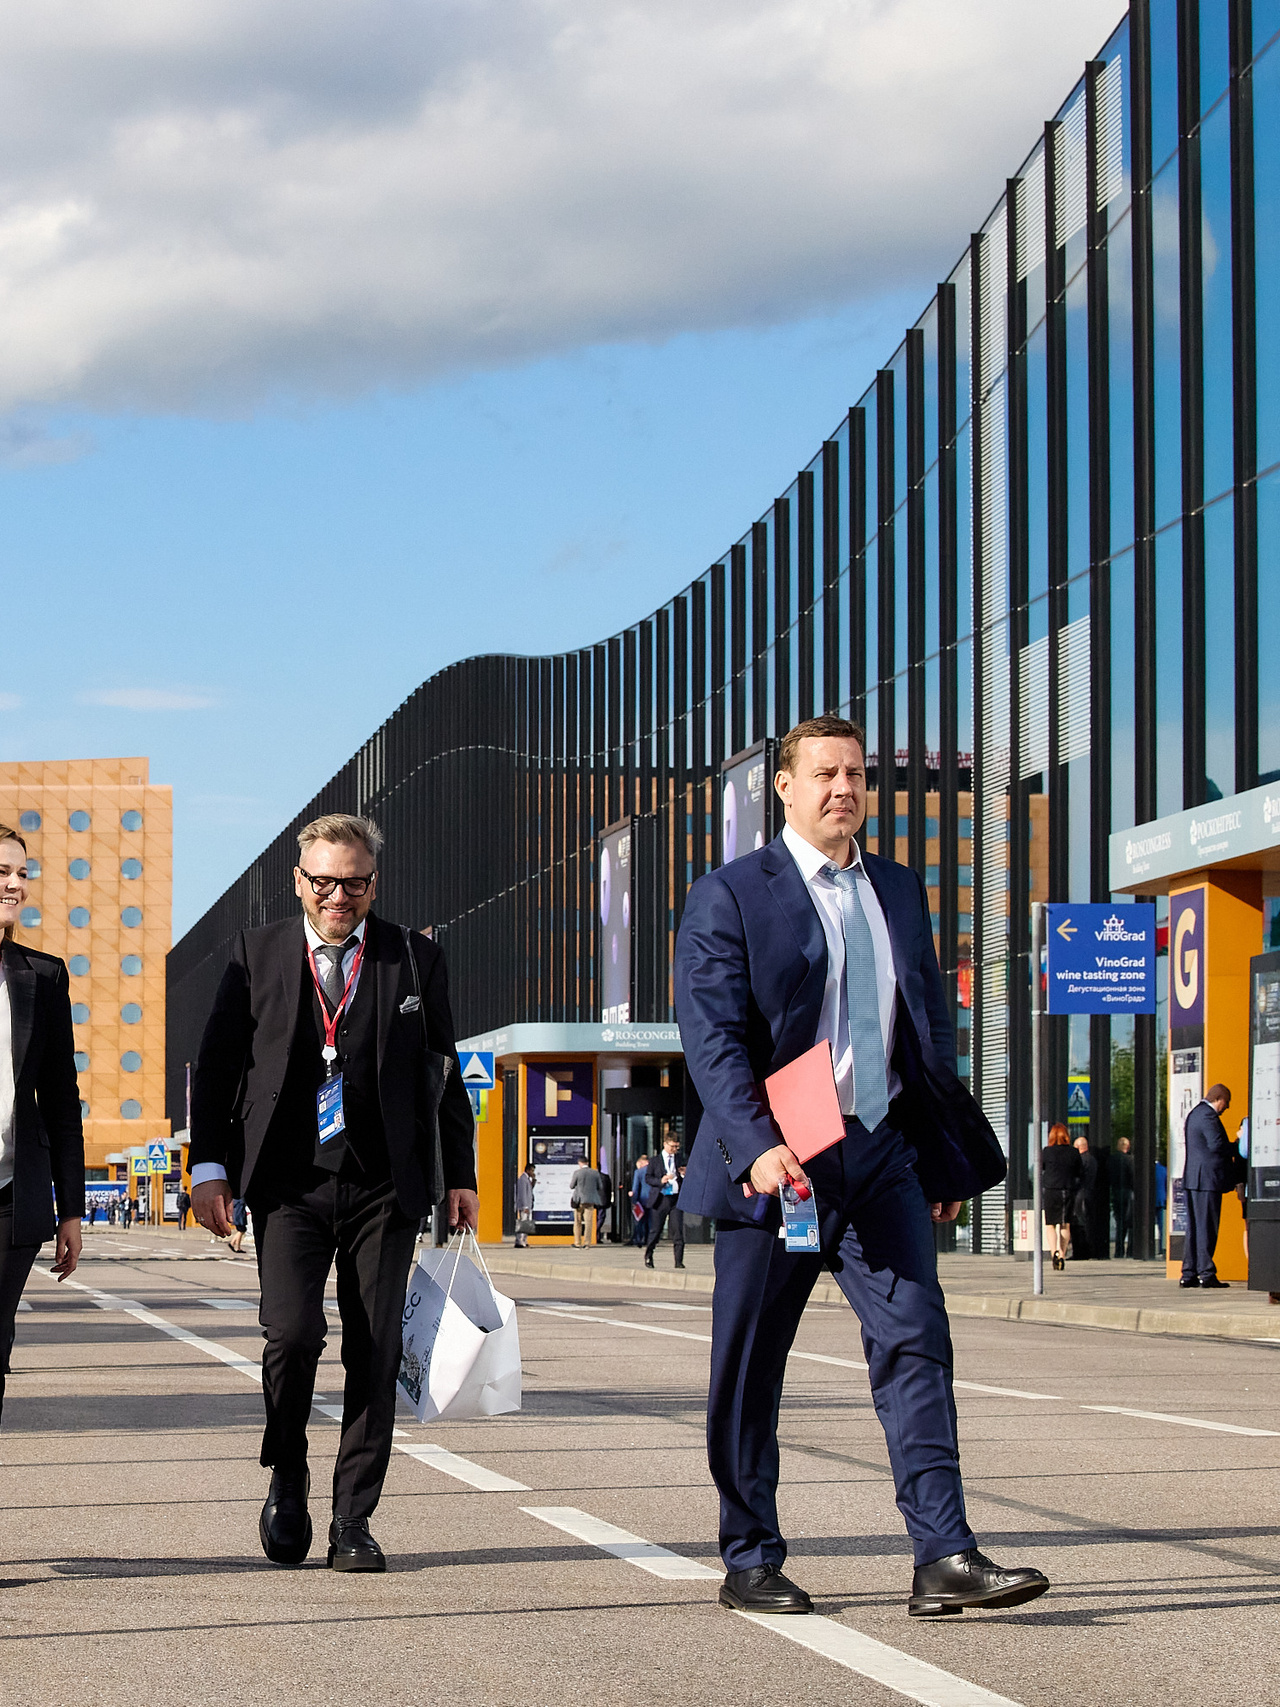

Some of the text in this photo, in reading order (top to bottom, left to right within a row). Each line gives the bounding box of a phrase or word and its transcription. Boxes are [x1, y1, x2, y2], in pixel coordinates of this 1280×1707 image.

[1094, 930, 1146, 941] VinoGrad
[1095, 956, 1145, 967] VinoGrad
[1174, 907, 1198, 1010] G
[1056, 969, 1146, 982] wine tasting zone
[1067, 984, 1127, 994] Дегустационная
[545, 1071, 573, 1117] F
